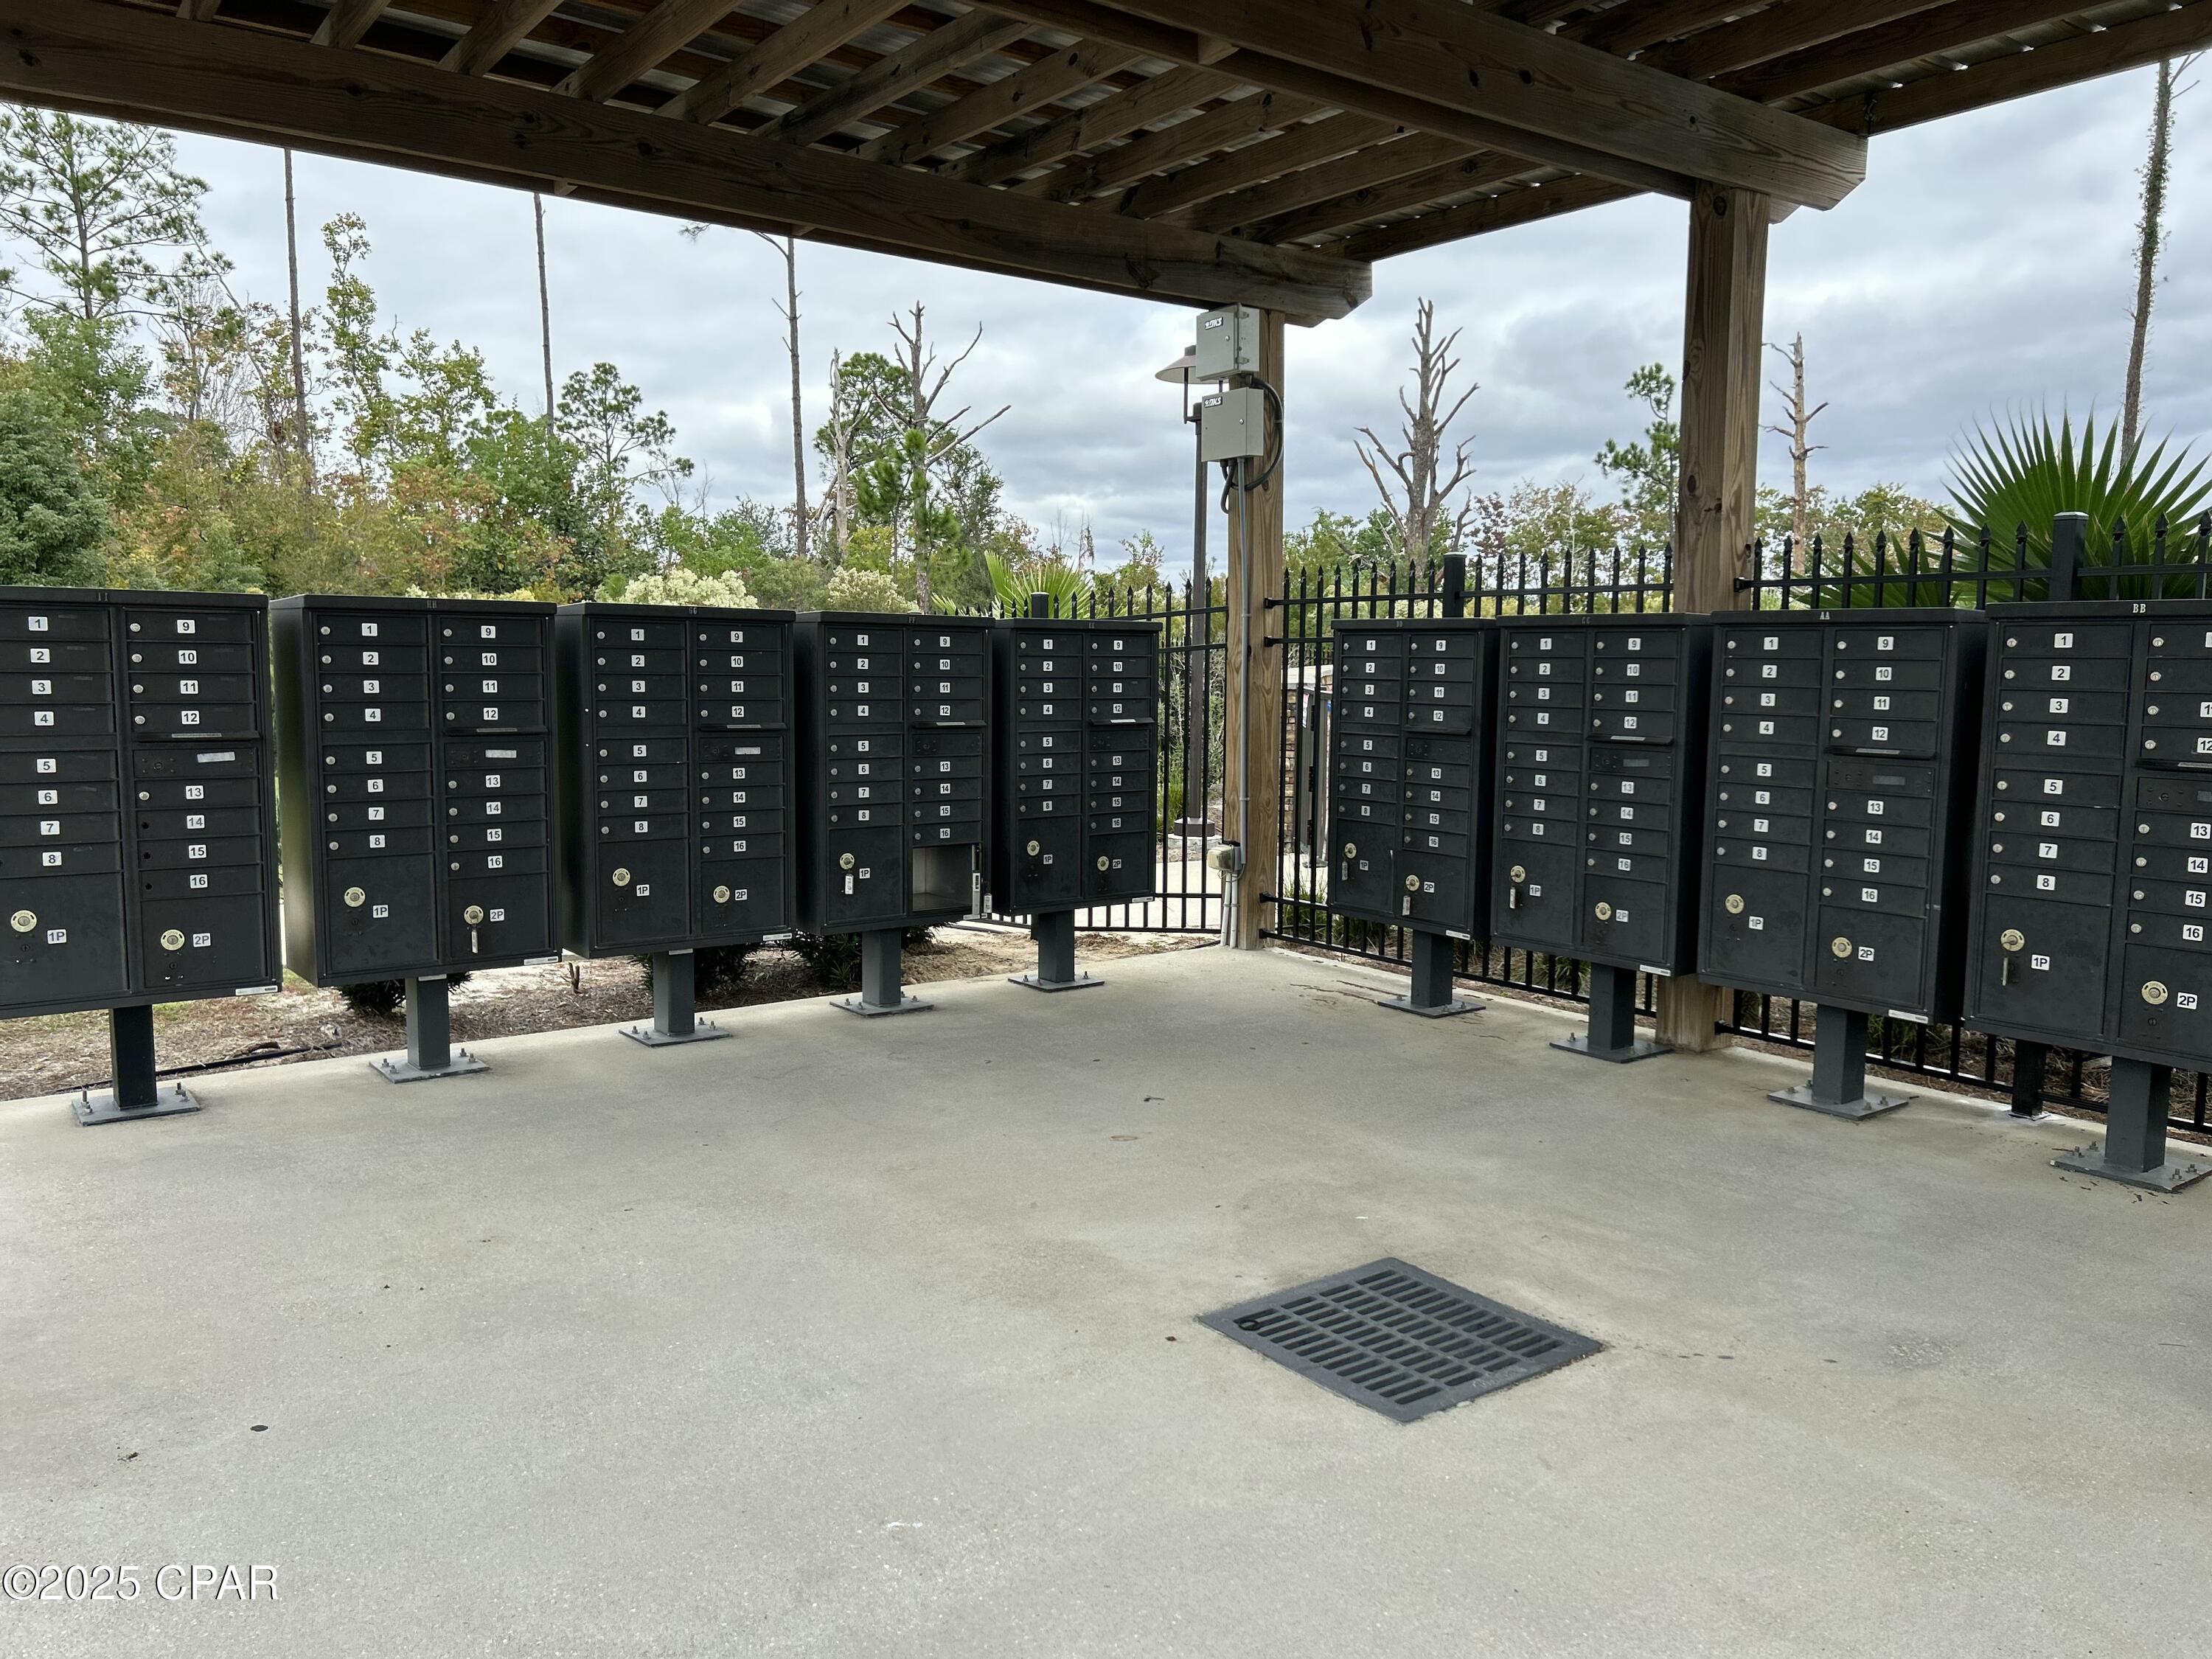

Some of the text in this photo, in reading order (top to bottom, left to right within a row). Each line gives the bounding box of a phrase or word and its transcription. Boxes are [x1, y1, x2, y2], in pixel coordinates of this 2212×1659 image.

[2132, 603, 2146, 613] BB
[1819, 611, 1830, 620] AA
[182, 622, 190, 632] 9
[485, 627, 492, 636] 9
[734, 632, 740, 641] 9
[942, 638, 947, 646] 9
[1631, 639, 1638, 648] 9
[1882, 639, 1889, 649] 9
[36, 650, 45, 661] 2
[180, 652, 195, 662] 10
[367, 653, 375, 664] 2
[483, 655, 495, 664] 10
[635, 656, 641, 666] 2
[732, 657, 742, 666] 10
[860, 659, 866, 668] 2
[941, 661, 949, 669] 10
[1542, 664, 1548, 673] 2
[1627, 665, 1638, 675] 10
[1766, 667, 1773, 676] 2
[2056, 667, 2065, 678] 2
[1878, 669, 1890, 679] 10
[38, 682, 46, 692] 3
[183, 682, 196, 692] 11
[368, 682, 375, 692] 3
[484, 682, 495, 691] 11
[636, 682, 641, 691] 3
[733, 682, 742, 691] 11
[860, 684, 866, 692] 3
[942, 684, 949, 692] 11
[1541, 689, 1547, 698] 3
[1627, 692, 1637, 701] 11
[1764, 695, 1771, 705] 3
[1877, 698, 1887, 709] 11
[860, 706, 866, 714] 4
[941, 706, 949, 714] 12
[2055, 700, 2063, 711] 3
[369, 710, 377, 720] 4
[485, 709, 497, 719] 12
[636, 707, 642, 717] 4
[733, 707, 742, 716] 12
[40, 713, 49, 724] 4
[184, 712, 198, 723] 12
[1540, 714, 1546, 723] 4
[1625, 718, 1635, 727] 12
[1763, 723, 1770, 732] 4
[1874, 728, 1886, 739] 12
[2052, 733, 2061, 743] 4
[637, 746, 643, 755] 5
[860, 742, 866, 750] 5
[371, 753, 378, 762] 5
[1539, 751, 1544, 760] 5
[43, 761, 51, 771] 5
[861, 765, 866, 773] 6
[941, 762, 949, 771] 13
[1761, 765, 1768, 775] 5
[637, 772, 644, 781] 6
[734, 769, 744, 778] 13
[487, 776, 499, 786] 13
[1537, 776, 1543, 785] 6
[372, 781, 379, 790] 6
[941, 785, 950, 793] 14
[2049, 782, 2057, 792] 5
[44, 792, 52, 802] 6
[187, 787, 202, 798] 13
[734, 793, 744, 801] 14
[861, 788, 866, 797] 7
[638, 797, 644, 806] 7
[1759, 793, 1766, 802] 6
[487, 803, 500, 813] 14
[1537, 801, 1543, 809] 7
[1870, 802, 1881, 813] 13
[372, 809, 380, 818] 7
[861, 811, 866, 819] 8
[941, 807, 949, 815] 15
[188, 817, 204, 827] 14
[734, 817, 744, 826] 15
[2046, 813, 2054, 824] 6
[46, 823, 55, 833] 7
[639, 822, 644, 832] 8
[1535, 825, 1541, 833] 8
[1758, 821, 1765, 830] 7
[488, 830, 501, 840] 15
[941, 830, 949, 838] 16
[2194, 825, 2208, 837] 13
[374, 837, 381, 846] 8
[1620, 834, 1630, 844] 15
[1868, 832, 1879, 842] 14
[735, 841, 745, 850] 16
[190, 846, 205, 857] 15
[1756, 849, 1763, 858] 8
[2044, 845, 2053, 856] 7
[48, 854, 56, 864] 8
[489, 857, 501, 866] 16
[1619, 860, 1630, 869] 16
[1866, 860, 1877, 871] 15
[2190, 859, 2205, 871] 14
[860, 869, 869, 877] 1P
[191, 876, 206, 886] 16
[2042, 877, 2050, 888] 8
[637, 886, 648, 895] 1P
[1530, 886, 1540, 895] 1P
[1864, 890, 1876, 900] 16
[736, 891, 746, 900] 2P
[2188, 893, 2203, 905] 15
[374, 906, 388, 917] 1P
[491, 911, 504, 920] 2P
[1750, 919, 1762, 928] 1P
[48, 931, 66, 942] 1P
[2185, 927, 2200, 939] 16
[194, 935, 209, 945] 2P
[1860, 948, 1873, 959] 2P
[2034, 957, 2048, 967] 1P
[2178, 995, 2196, 1006] 2P
